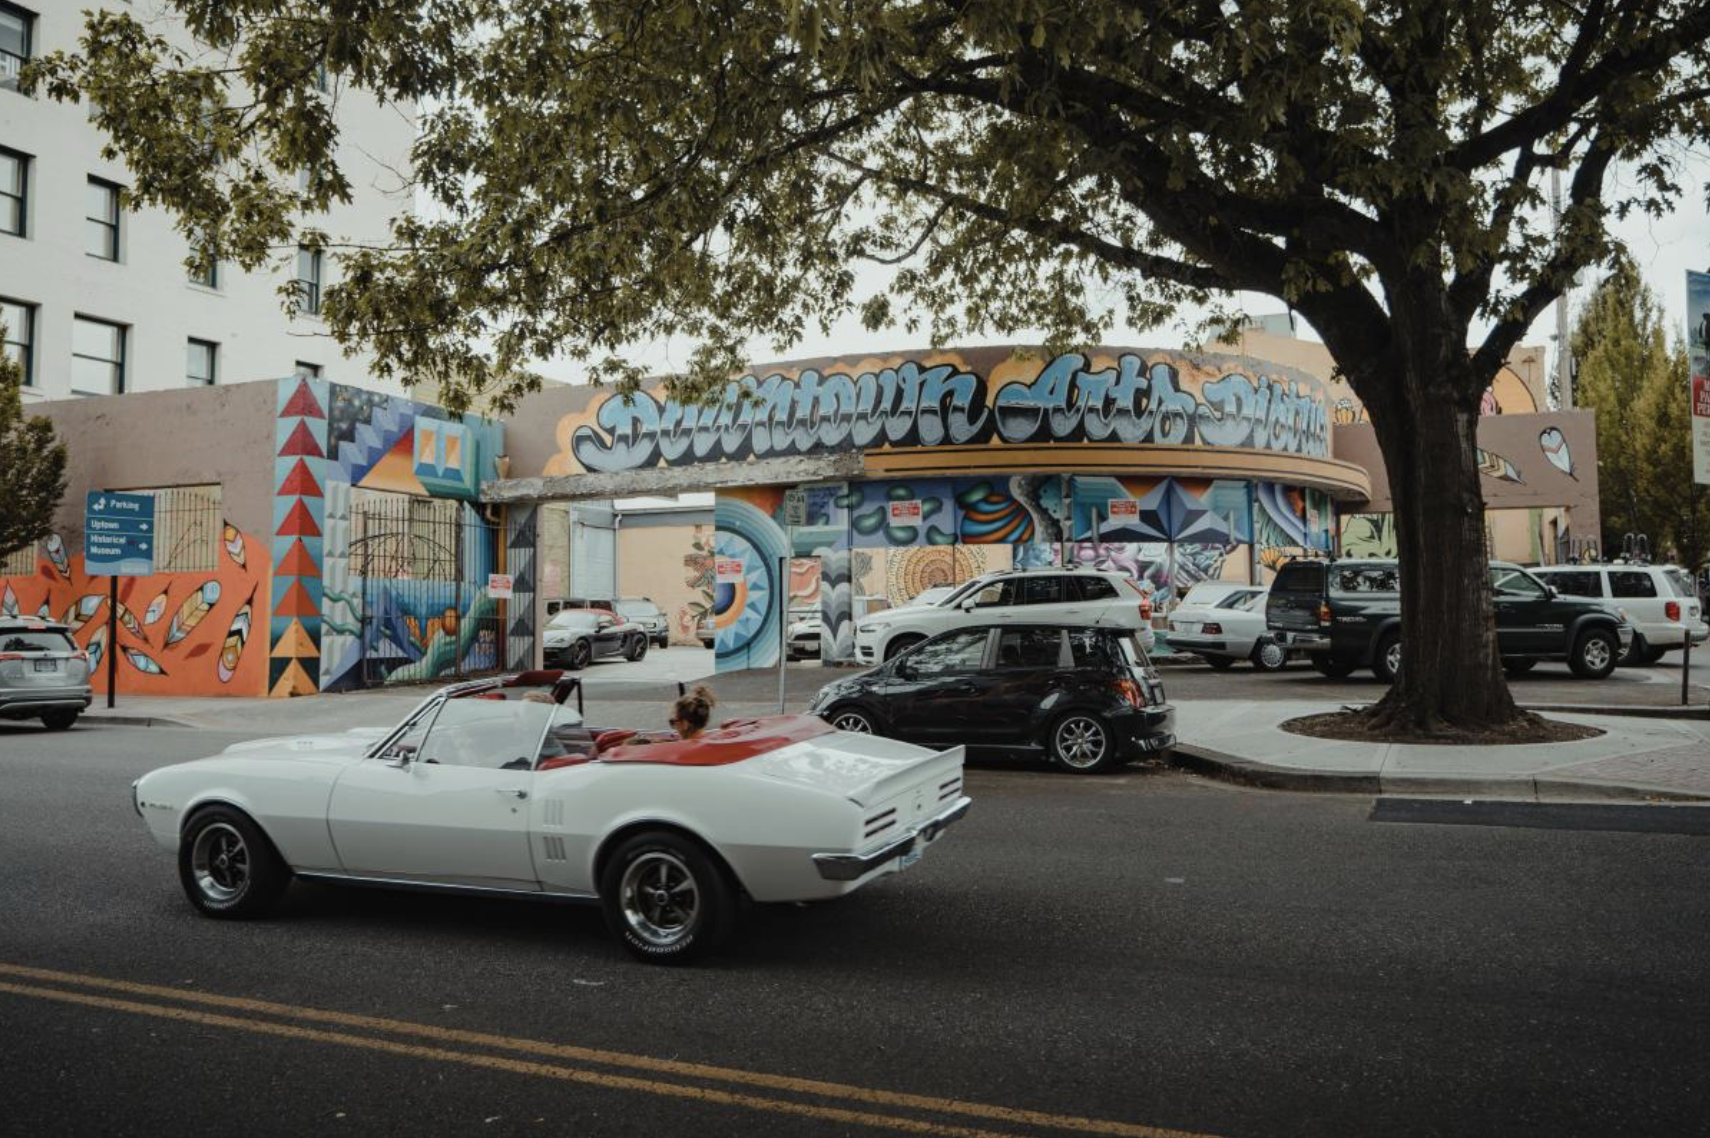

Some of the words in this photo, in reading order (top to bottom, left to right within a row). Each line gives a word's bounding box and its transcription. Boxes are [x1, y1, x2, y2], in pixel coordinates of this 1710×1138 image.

[572, 361, 988, 472] Downtown
[994, 353, 1197, 444] Arts
[110, 500, 140, 512] Parking
[91, 520, 120, 530] Uptown
[90, 534, 127, 544] Historical
[90, 545, 121, 555] Museum
